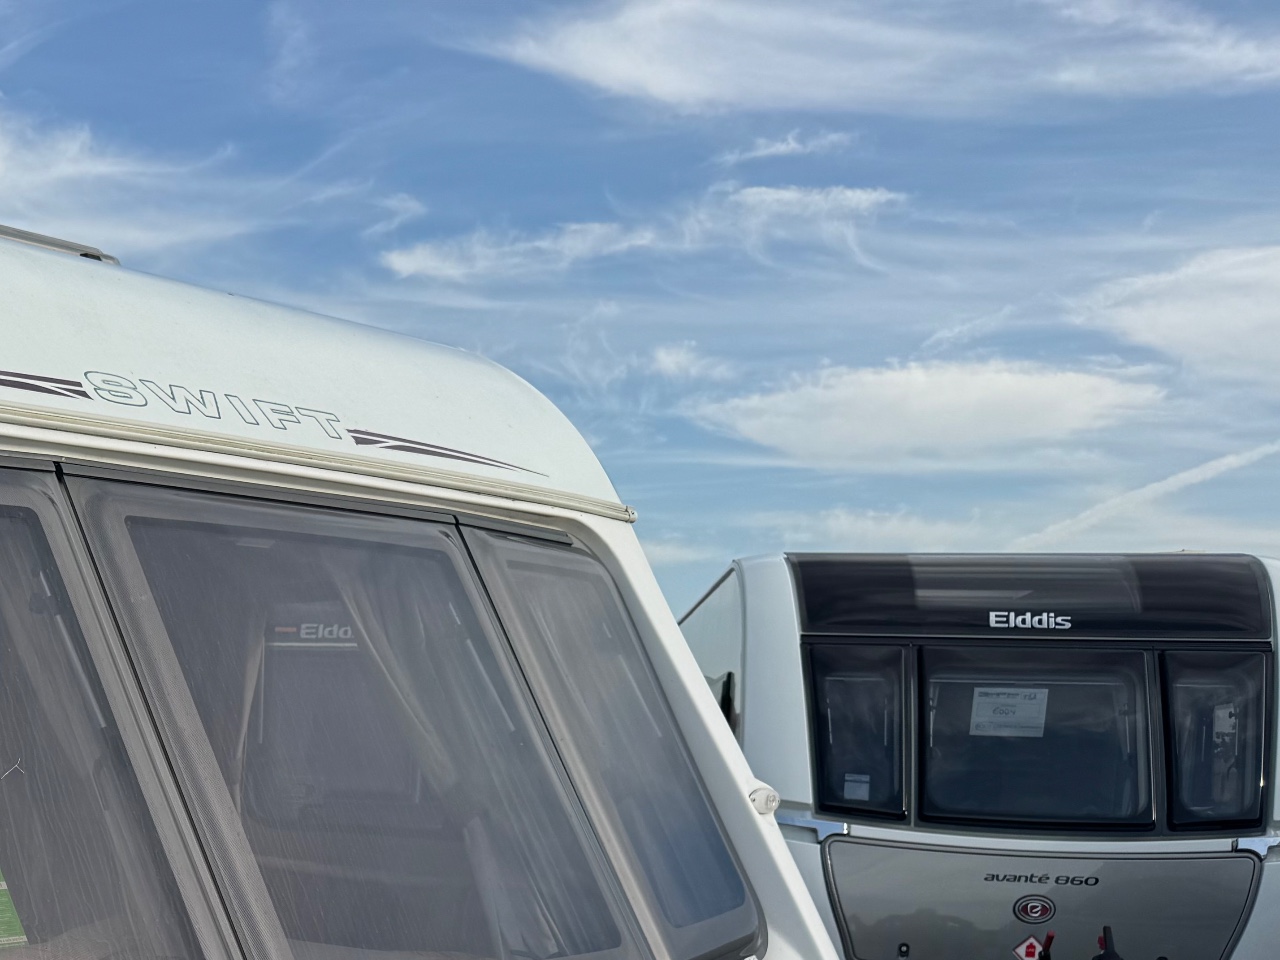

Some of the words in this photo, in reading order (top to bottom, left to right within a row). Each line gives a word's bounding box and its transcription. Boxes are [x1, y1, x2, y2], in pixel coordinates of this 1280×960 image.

[83, 370, 343, 440] SWIFT
[989, 611, 1072, 630] Elddis
[983, 873, 1050, 885] avanté
[1054, 875, 1100, 887] 860
